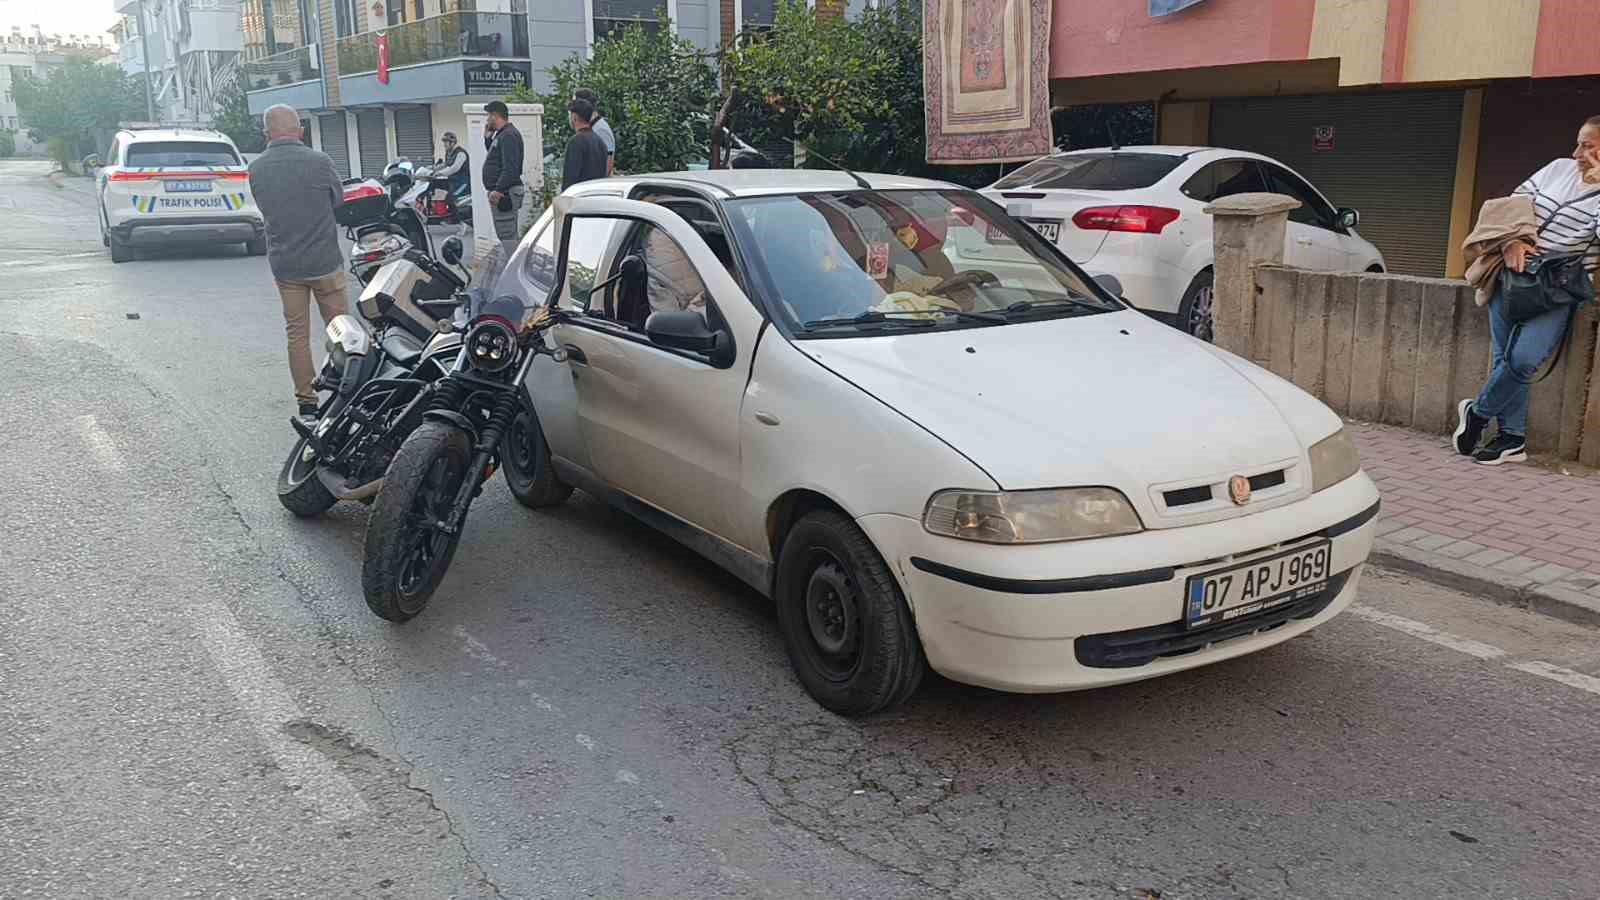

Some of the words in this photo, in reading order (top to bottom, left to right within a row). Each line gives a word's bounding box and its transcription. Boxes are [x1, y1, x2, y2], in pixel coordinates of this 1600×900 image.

[1203, 575, 1233, 610] 07
[1241, 561, 1285, 600] APJ
[1287, 548, 1326, 585] 969
